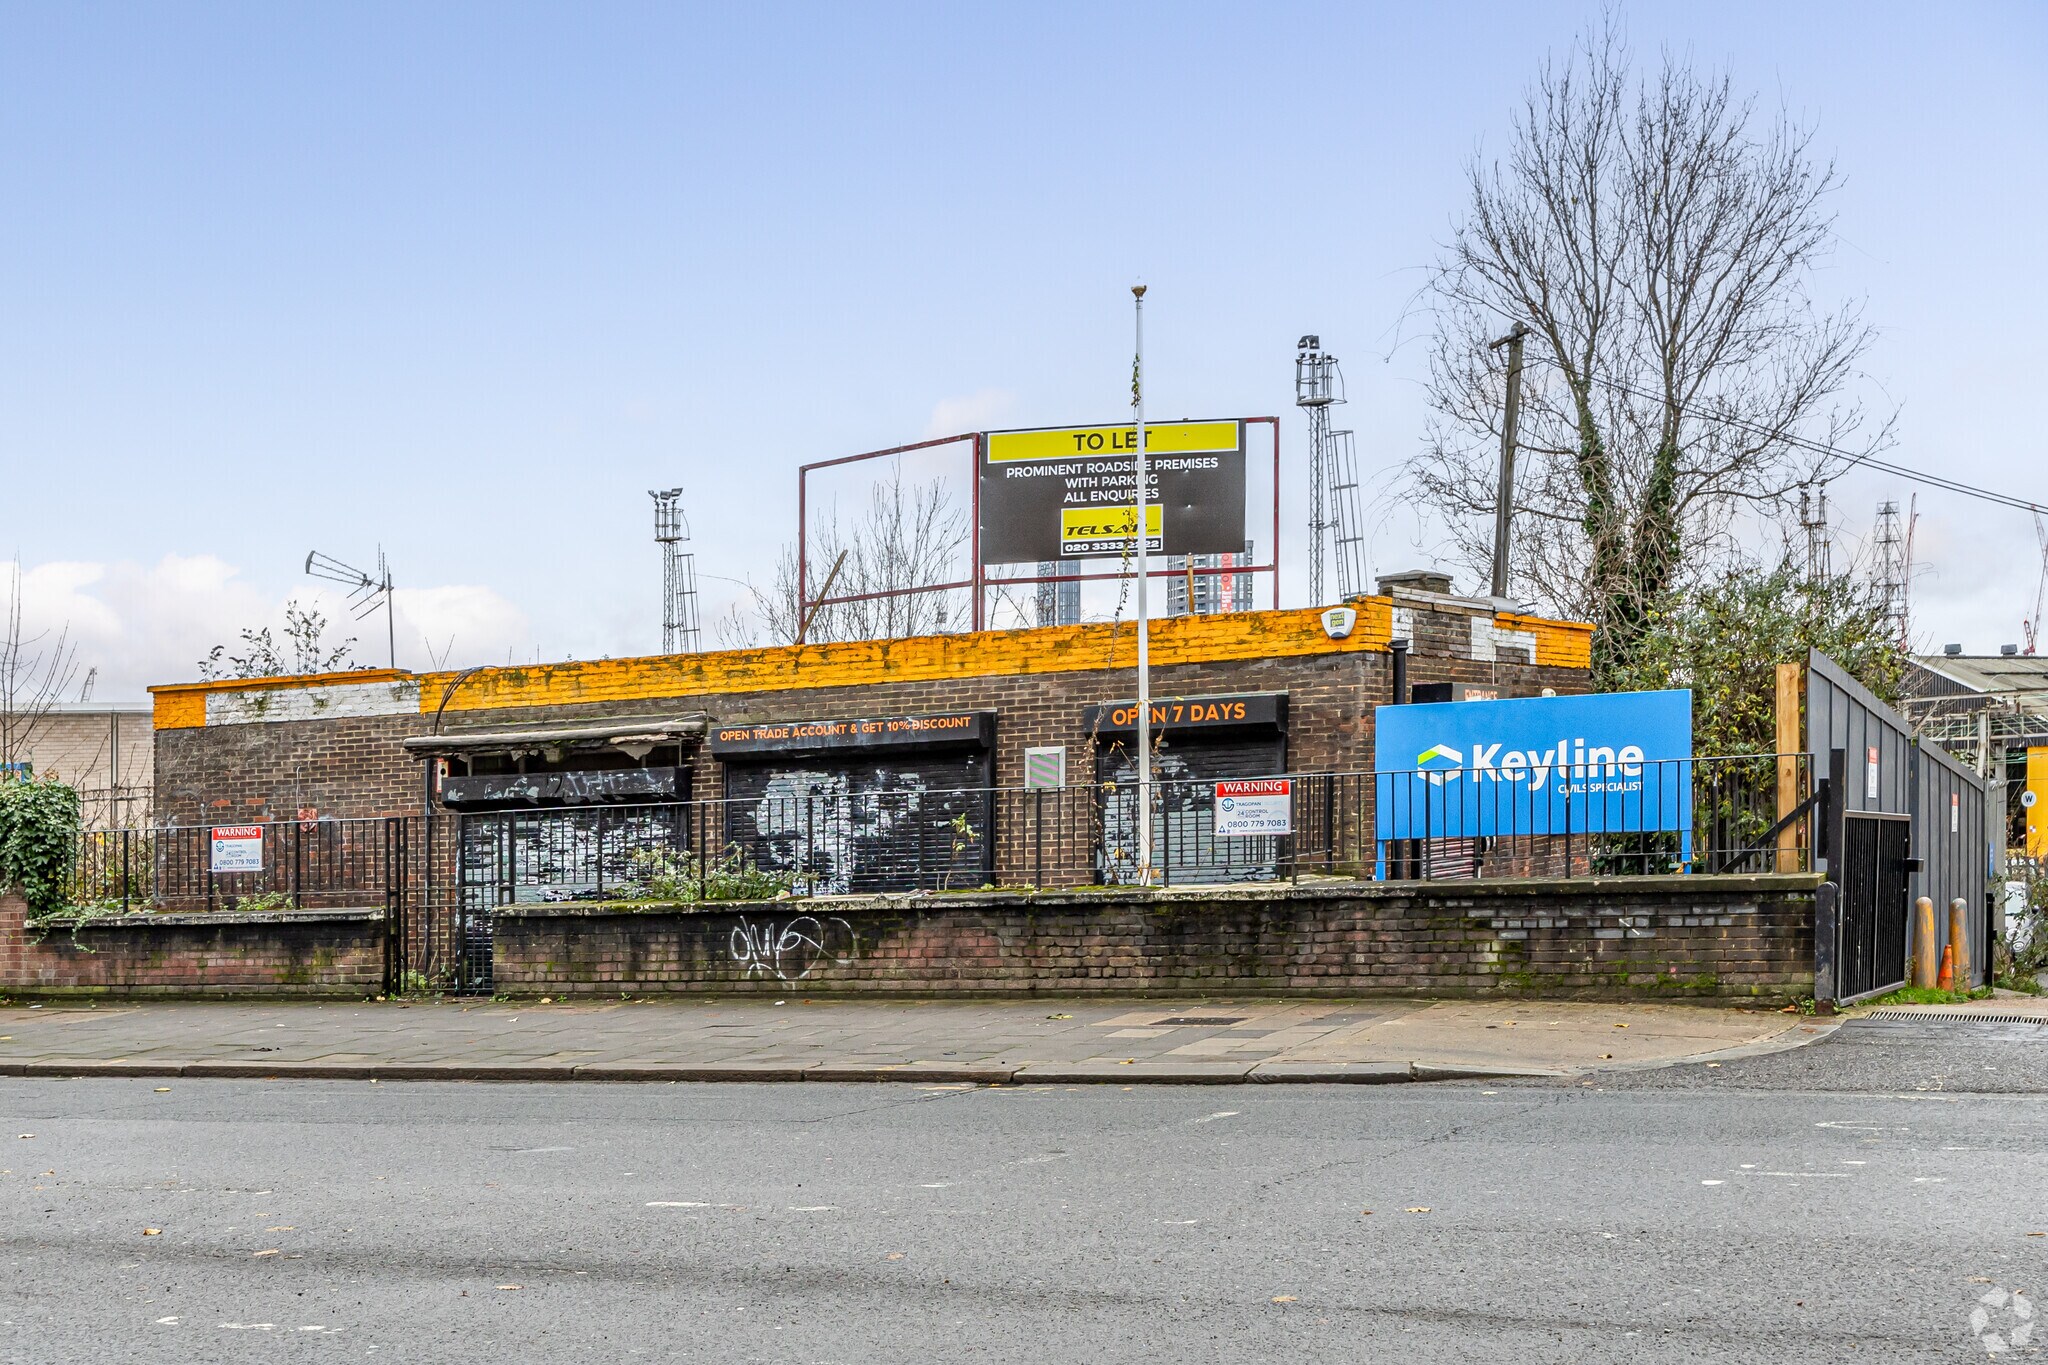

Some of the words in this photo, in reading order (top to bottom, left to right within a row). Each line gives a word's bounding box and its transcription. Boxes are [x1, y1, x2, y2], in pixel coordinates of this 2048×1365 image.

[1073, 433, 1104, 451] TO
[1112, 431, 1152, 449] LET
[1006, 463, 1083, 478] PROMINENT
[1155, 457, 1219, 470] PREMISES
[1065, 477, 1098, 489] WITH
[1064, 492, 1087, 503] ALL
[1090, 488, 1159, 502] ENQUIRES
[1065, 543, 1090, 552] 020
[1092, 541, 1124, 550] 3333
[1112, 707, 1166, 725] OPN
[1172, 705, 1184, 723] 7
[1190, 702, 1246, 722] DAYS
[720, 730, 750, 741] OPEN
[753, 728, 790, 739] TRADE
[792, 724, 847, 737] ACCOUNT
[850, 723, 858, 734] &
[861, 722, 884, 733] GET
[887, 720, 910, 732] 10%
[912, 716, 971, 731] DISCOUNT
[1472, 738, 1644, 791] Keyline
[1223, 781, 1283, 793] WARNING
[2025, 795, 2033, 803] W
[1227, 820, 1249, 828] 0800
[1266, 819, 1287, 827] 7083
[218, 827, 257, 836] WARNING
